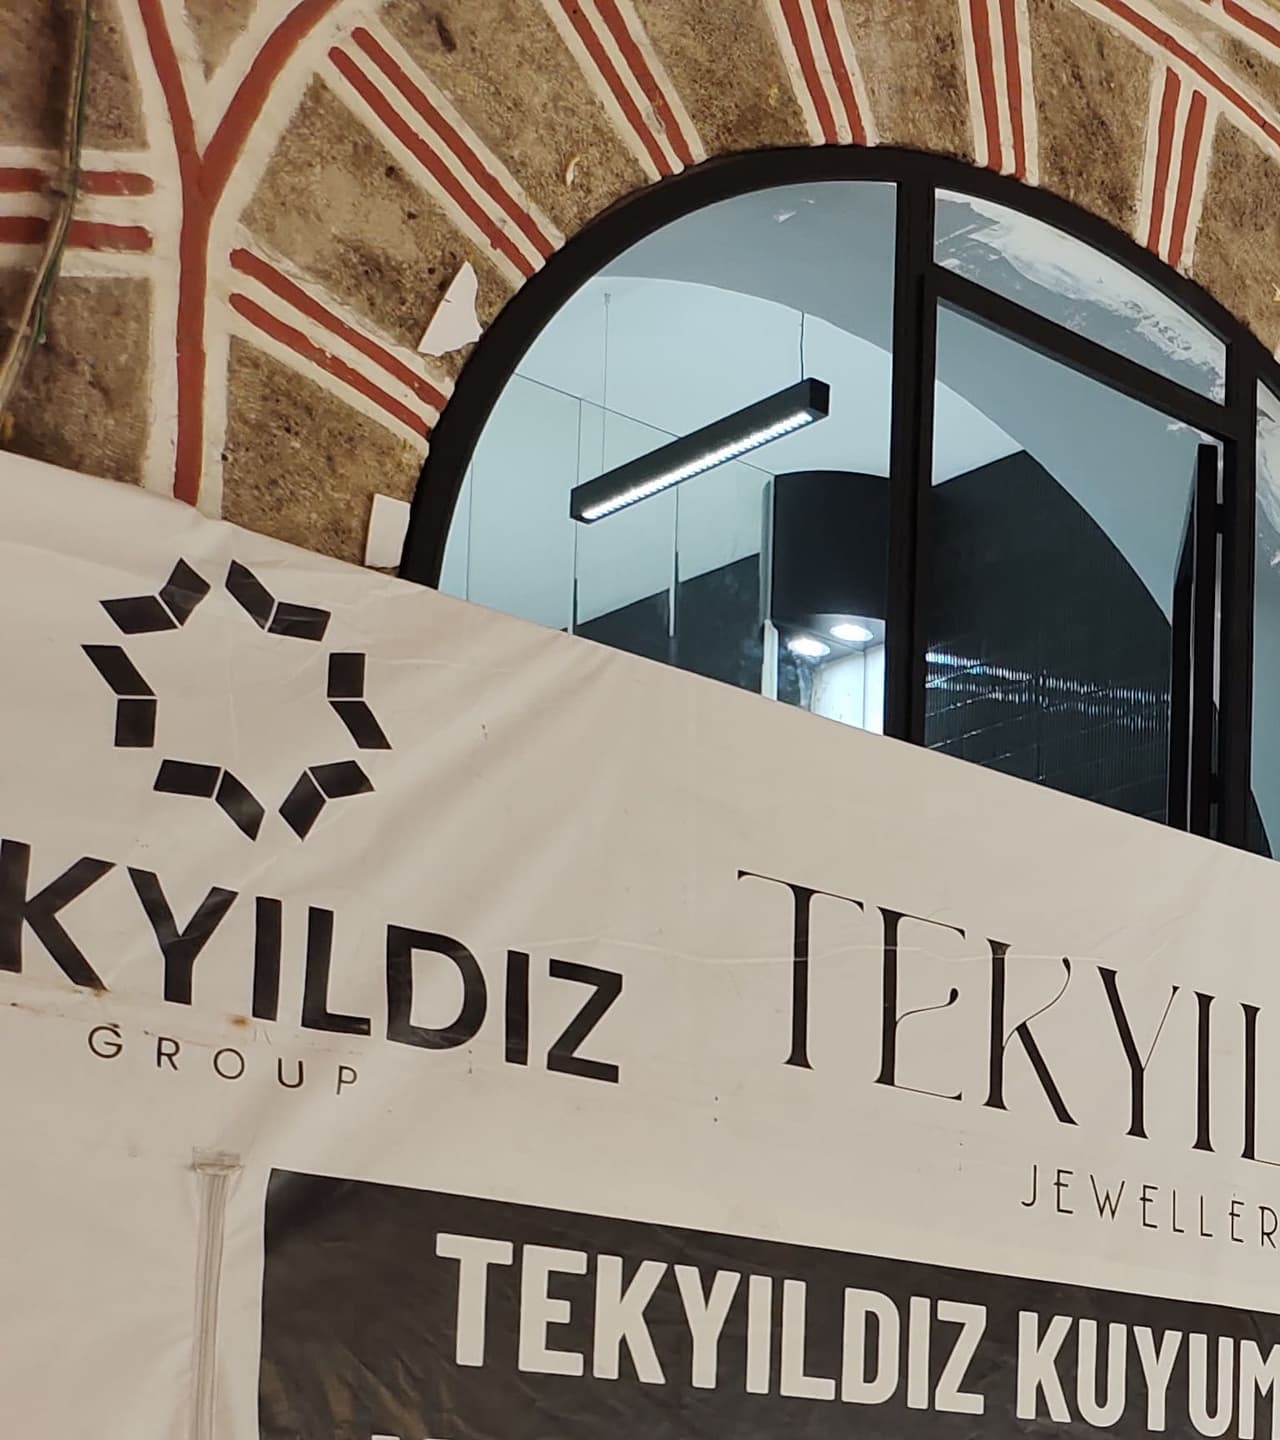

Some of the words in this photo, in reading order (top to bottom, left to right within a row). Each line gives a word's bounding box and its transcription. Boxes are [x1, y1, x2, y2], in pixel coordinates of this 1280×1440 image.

[0, 839, 624, 1084] KYILDIZ
[88, 1022, 359, 1095] GROUP
[435, 1232, 987, 1415] TEKYILDIZ
